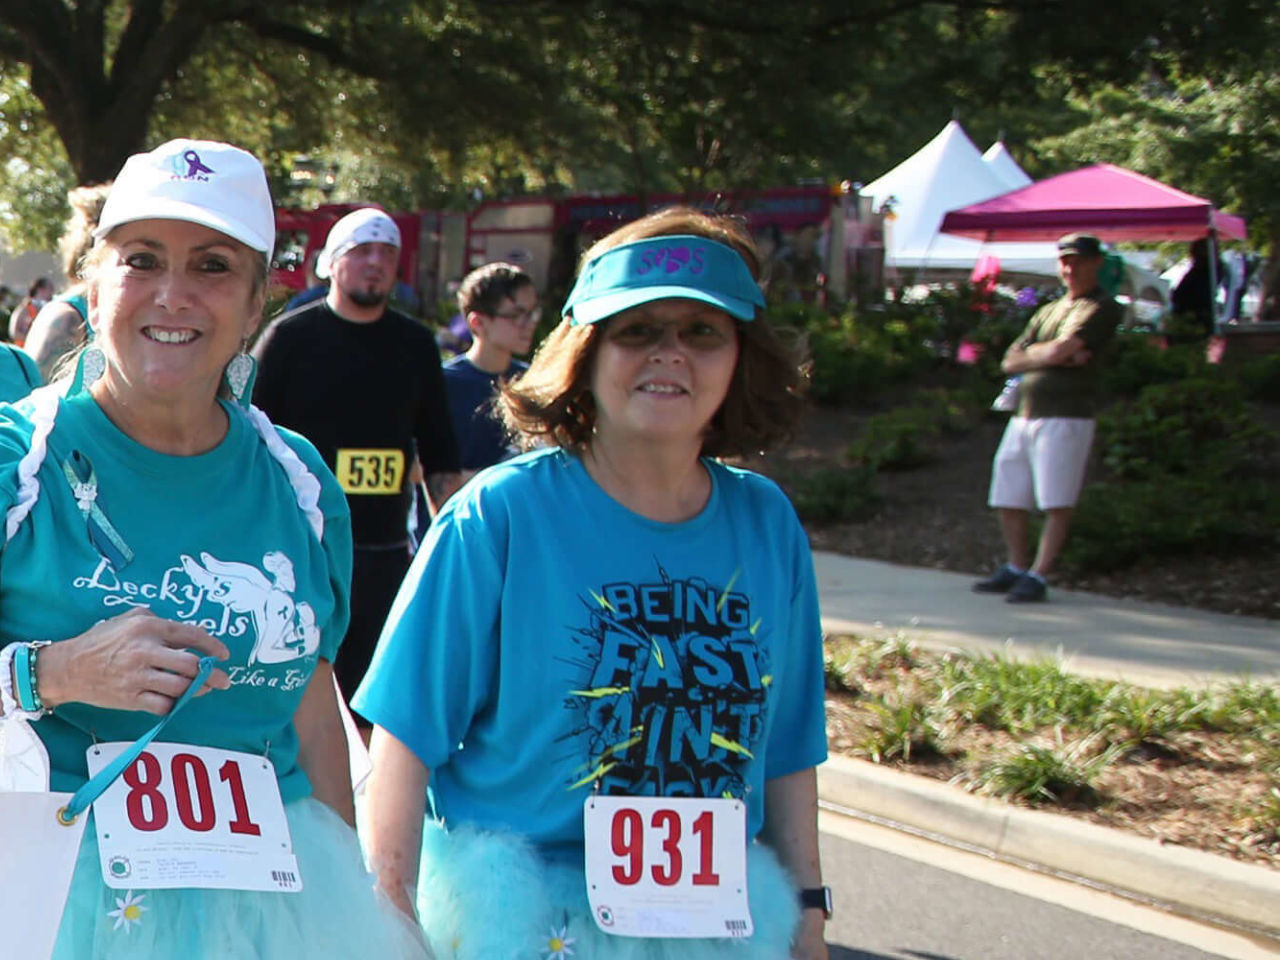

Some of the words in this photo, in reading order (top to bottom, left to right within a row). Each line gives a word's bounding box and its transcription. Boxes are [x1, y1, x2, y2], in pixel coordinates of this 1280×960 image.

[348, 455, 396, 488] 535
[603, 580, 750, 630] BEING
[229, 666, 265, 687] Like
[268, 677, 279, 688] a
[590, 630, 763, 690] FAST
[590, 697, 761, 766] AIN'T
[123, 751, 261, 836] 801
[610, 808, 720, 887] 931
